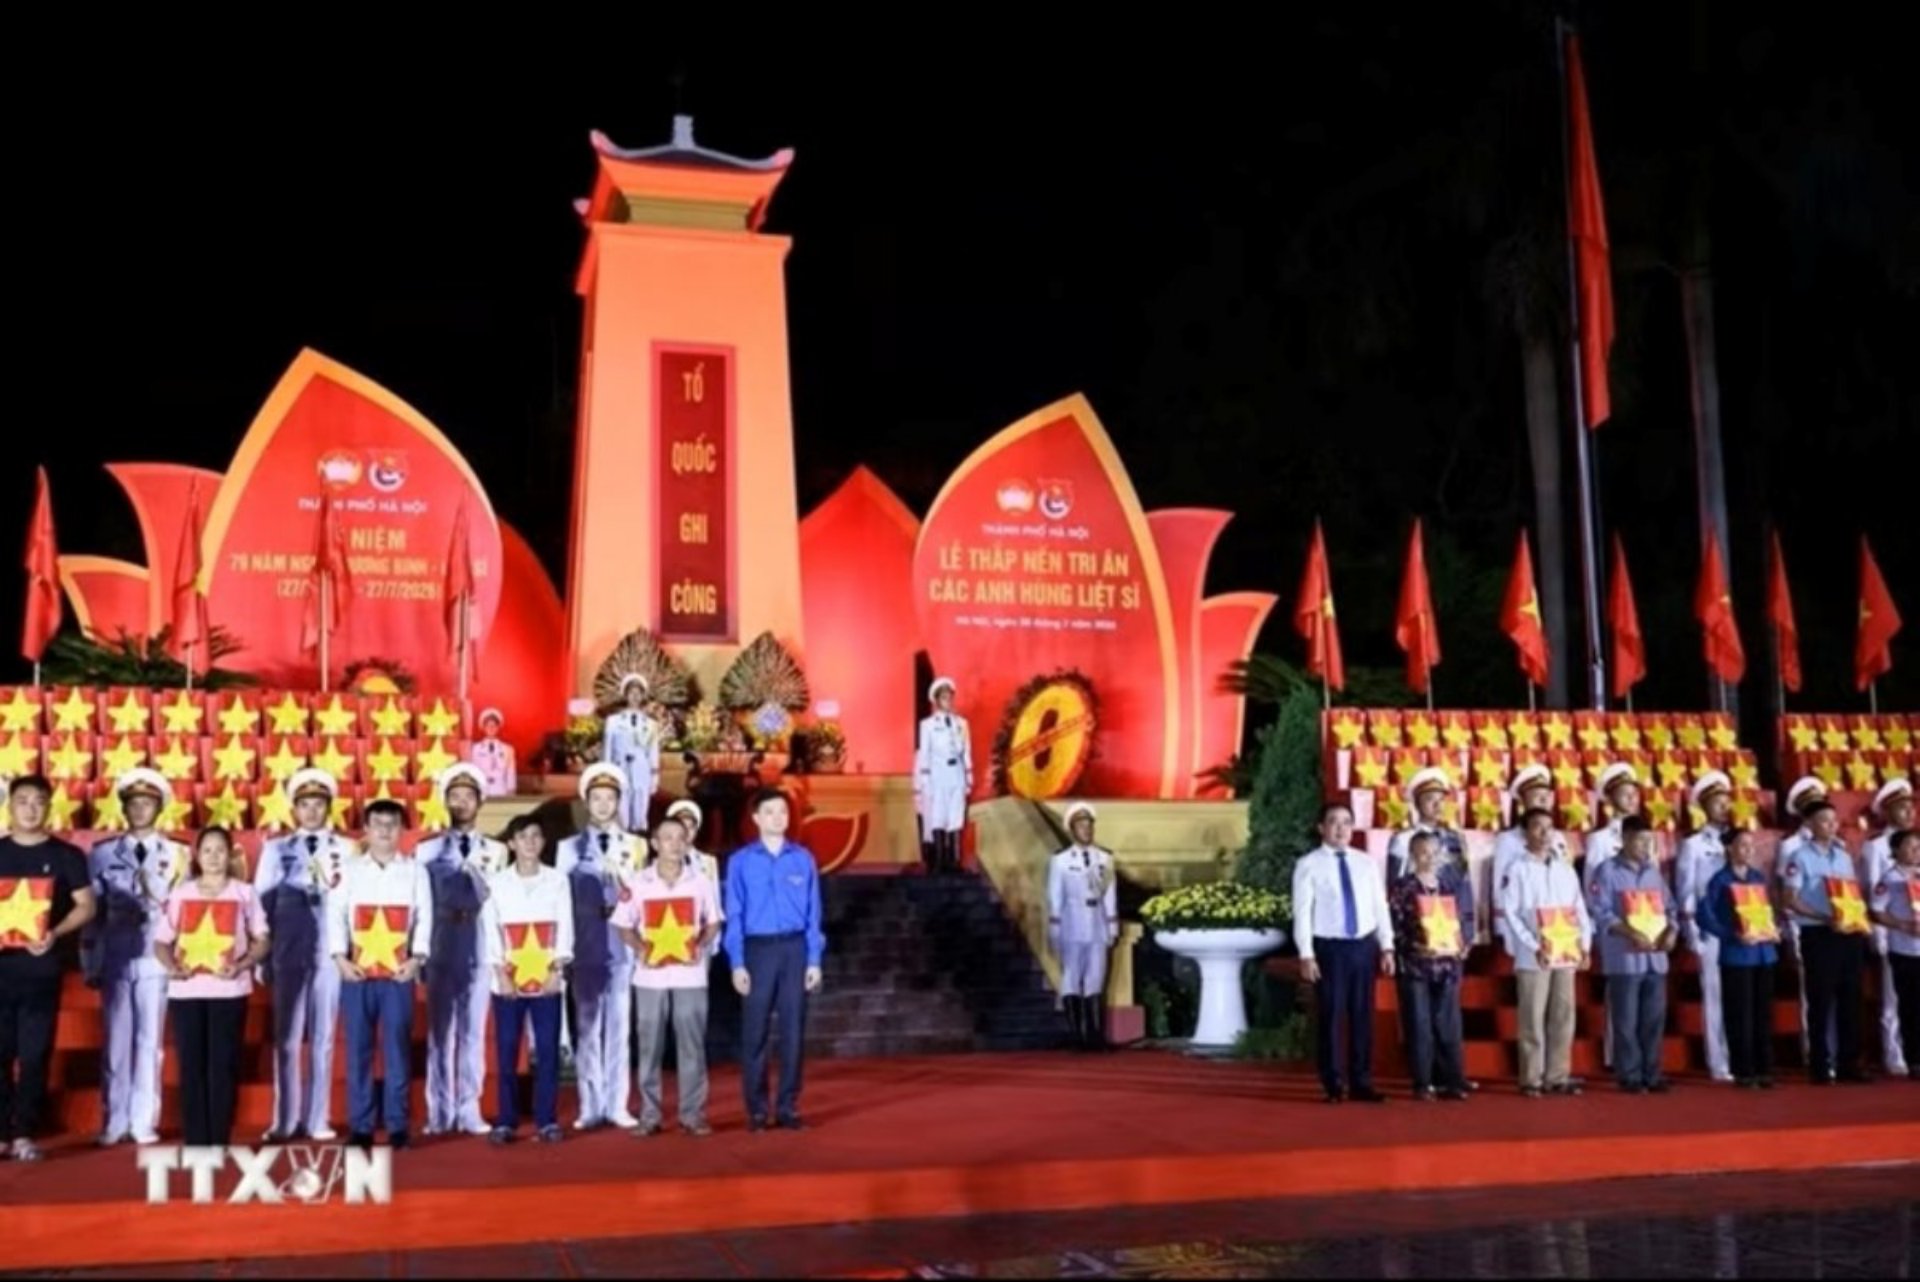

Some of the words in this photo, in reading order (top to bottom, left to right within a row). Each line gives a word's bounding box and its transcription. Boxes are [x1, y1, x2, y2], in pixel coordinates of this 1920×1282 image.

[671, 432, 717, 475] QUỐC
[350, 525, 406, 555] NIỆM
[679, 513, 709, 543] GHI
[1067, 550, 1097, 576] TRI
[1101, 547, 1129, 577] ÂN
[670, 578, 718, 615] CÔNG
[929, 577, 969, 602] CÁC
[975, 581, 1015, 604] ANH
[1077, 580, 1117, 612] LIỆT
